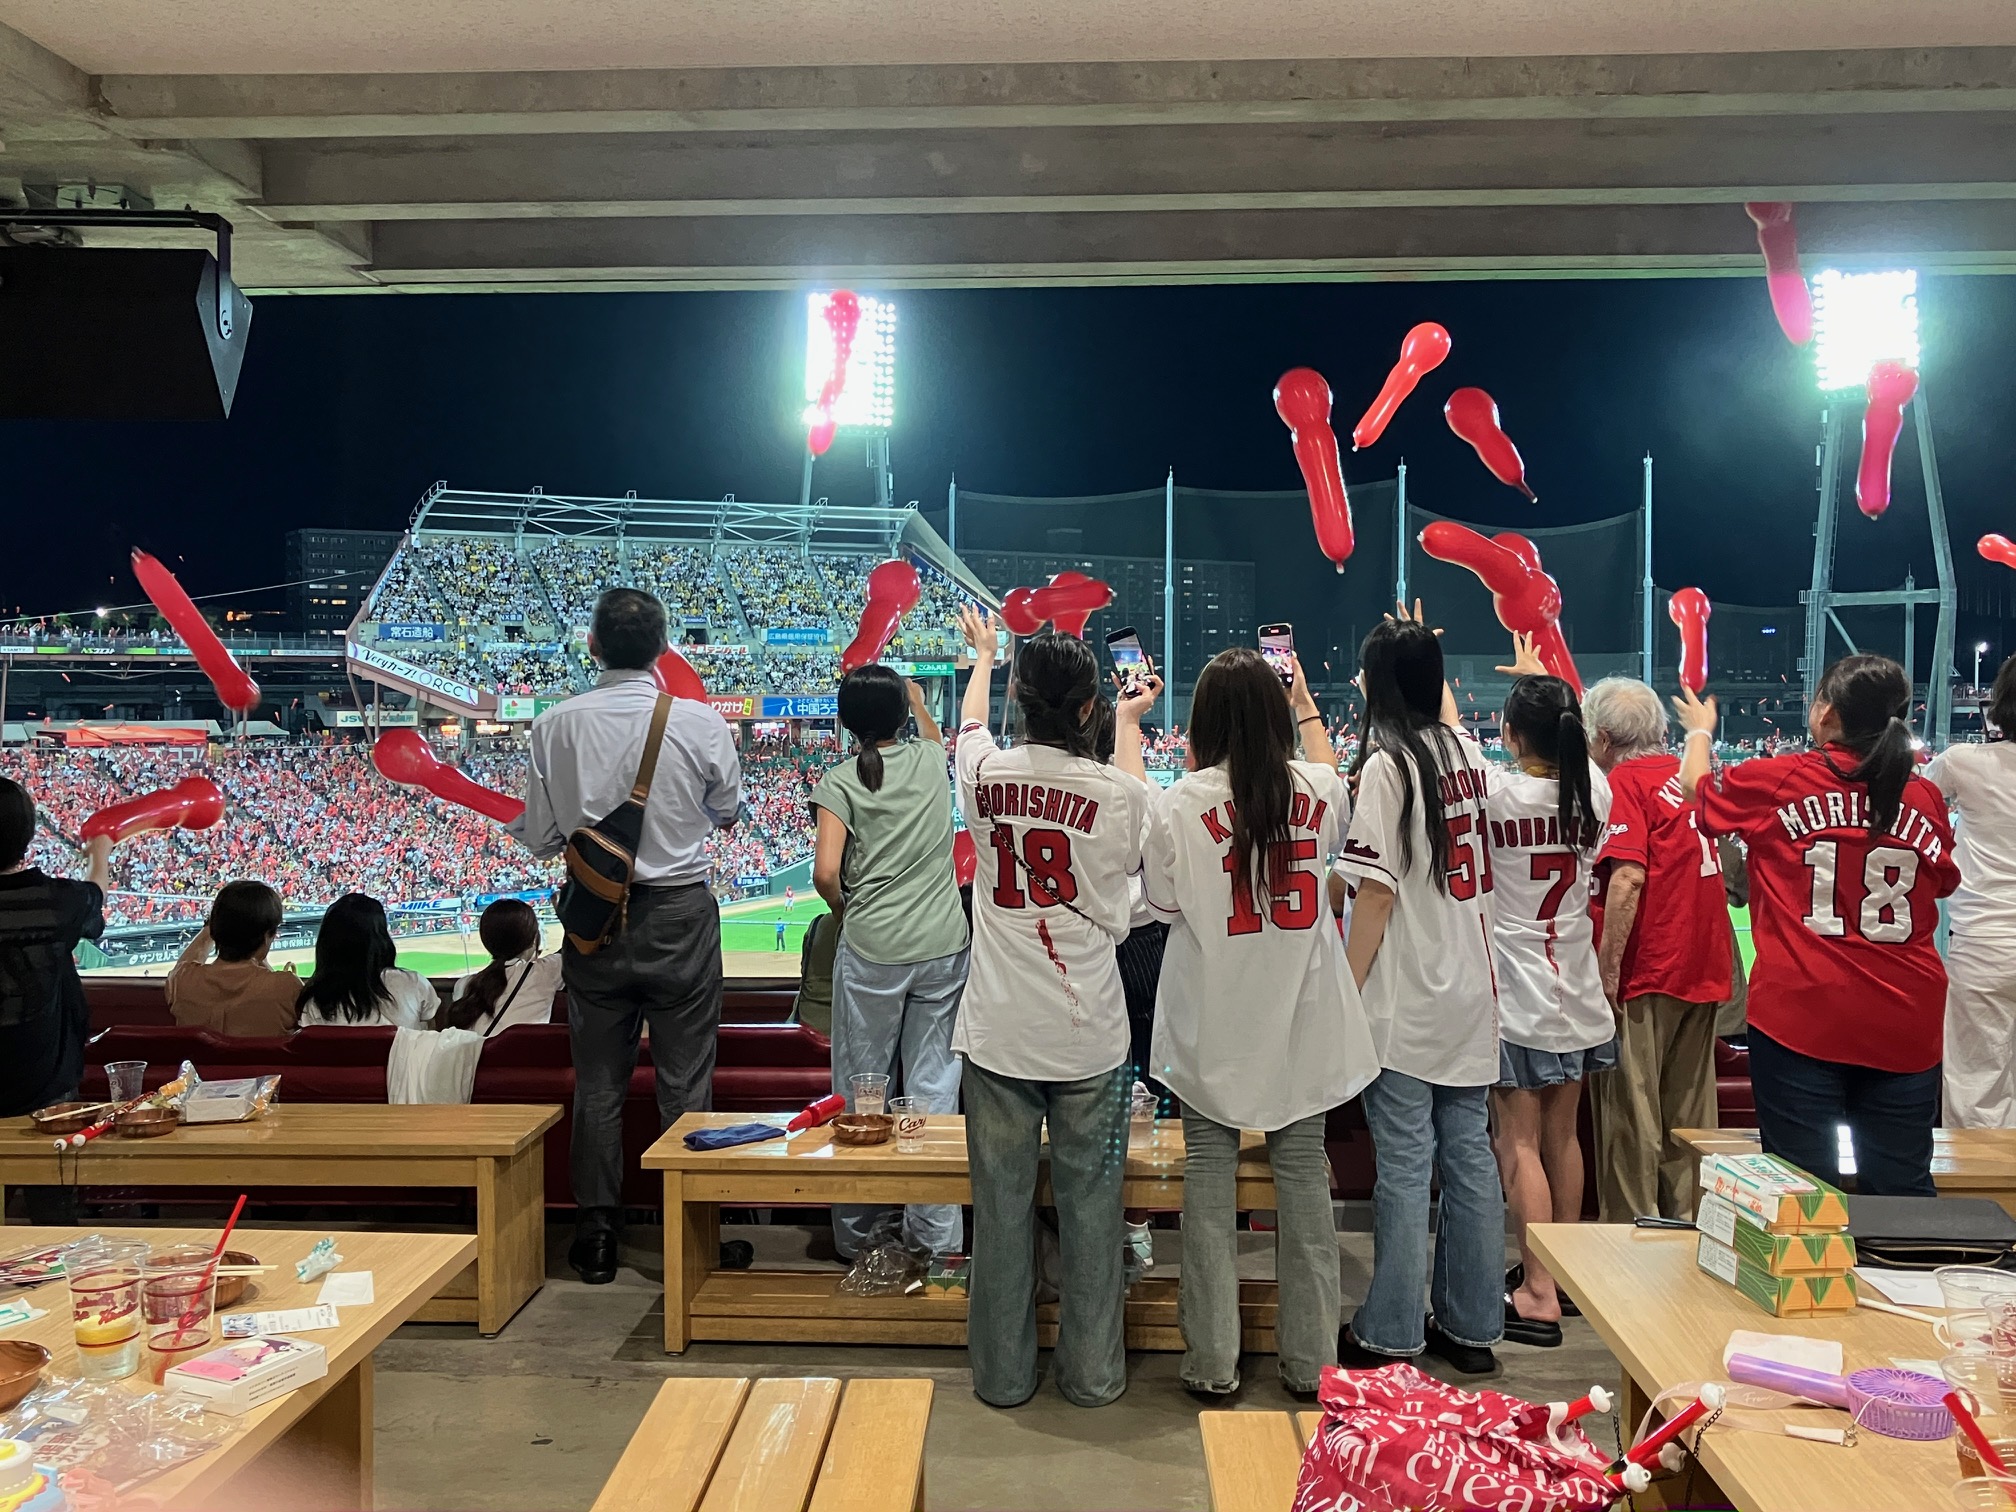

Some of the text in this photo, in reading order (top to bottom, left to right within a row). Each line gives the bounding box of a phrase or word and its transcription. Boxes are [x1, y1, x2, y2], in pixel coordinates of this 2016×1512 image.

[390, 626, 434, 638] 常石造船
[361, 650, 464, 697] Veryカープ! RCC
[341, 714, 370, 723] JSW
[711, 701, 744, 714] りかけ
[975, 783, 1099, 834] MORISHITA
[1200, 792, 1327, 845] KDA
[1777, 791, 1943, 863] MORIITA
[990, 822, 1079, 909] 18
[1443, 808, 1494, 902] 51
[1688, 810, 1723, 878] 1
[401, 900, 442, 910] MIIKE
[1222, 838, 1319, 937] 15
[1530, 852, 1578, 921] 7
[1803, 840, 1920, 943] 18
[140, 950, 179, 964] サンセルモ
